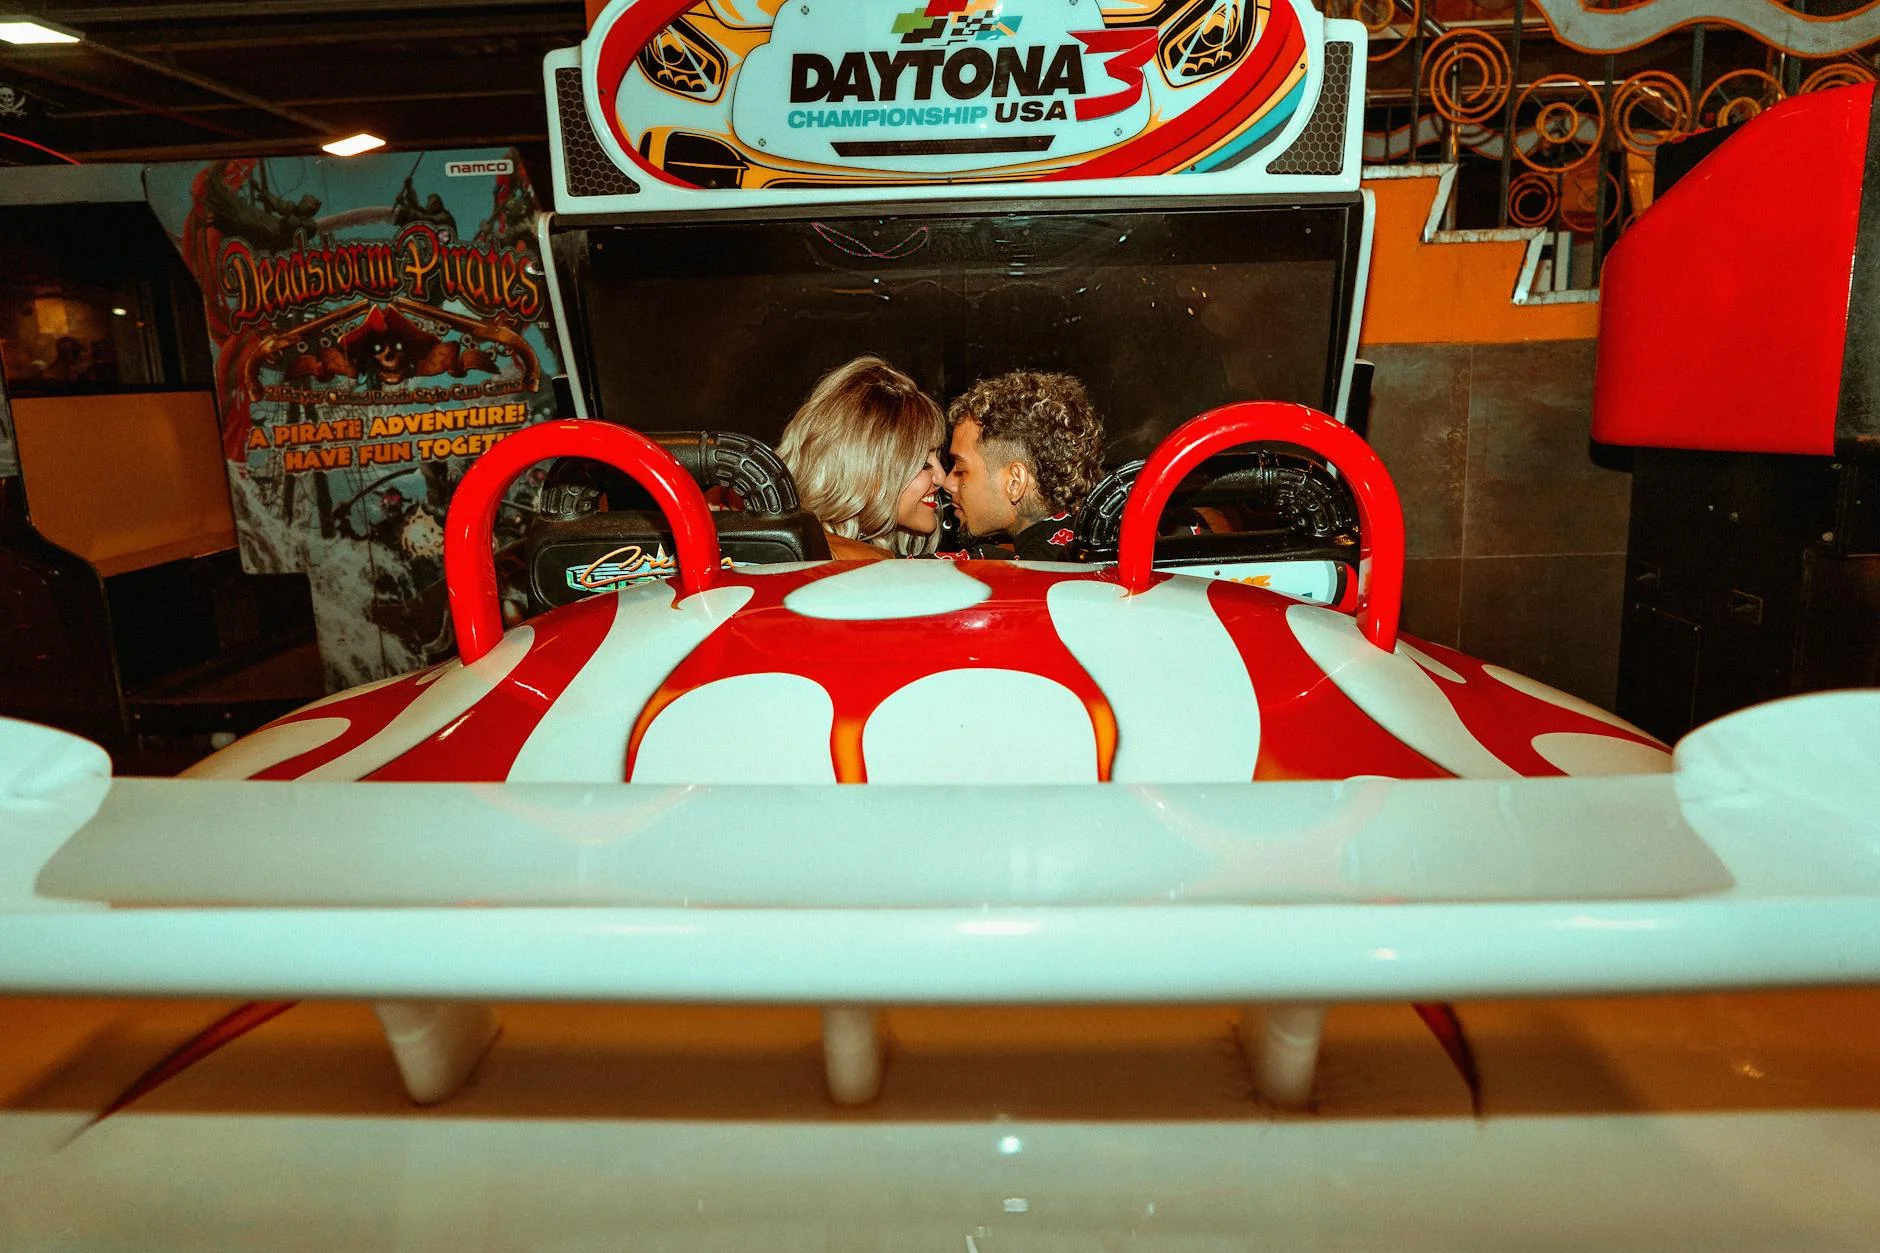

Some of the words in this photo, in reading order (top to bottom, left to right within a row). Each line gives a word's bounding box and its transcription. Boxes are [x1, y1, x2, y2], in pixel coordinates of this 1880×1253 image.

[789, 44, 1087, 104] DAYTONA
[1066, 26, 1159, 122] 3
[787, 106, 988, 129] CHAMPIONSHIP
[994, 100, 1068, 123] USA
[450, 162, 508, 174] namco
[222, 233, 400, 320] Deadstorm
[396, 223, 541, 317] Pirates
[451, 385, 479, 399] Gun
[482, 380, 522, 396] Game
[247, 427, 271, 449] A
[273, 417, 362, 447] PIRATE
[368, 403, 527, 437] ADVENTURE!
[284, 446, 351, 471] HAVE
[359, 441, 412, 467] FUN
